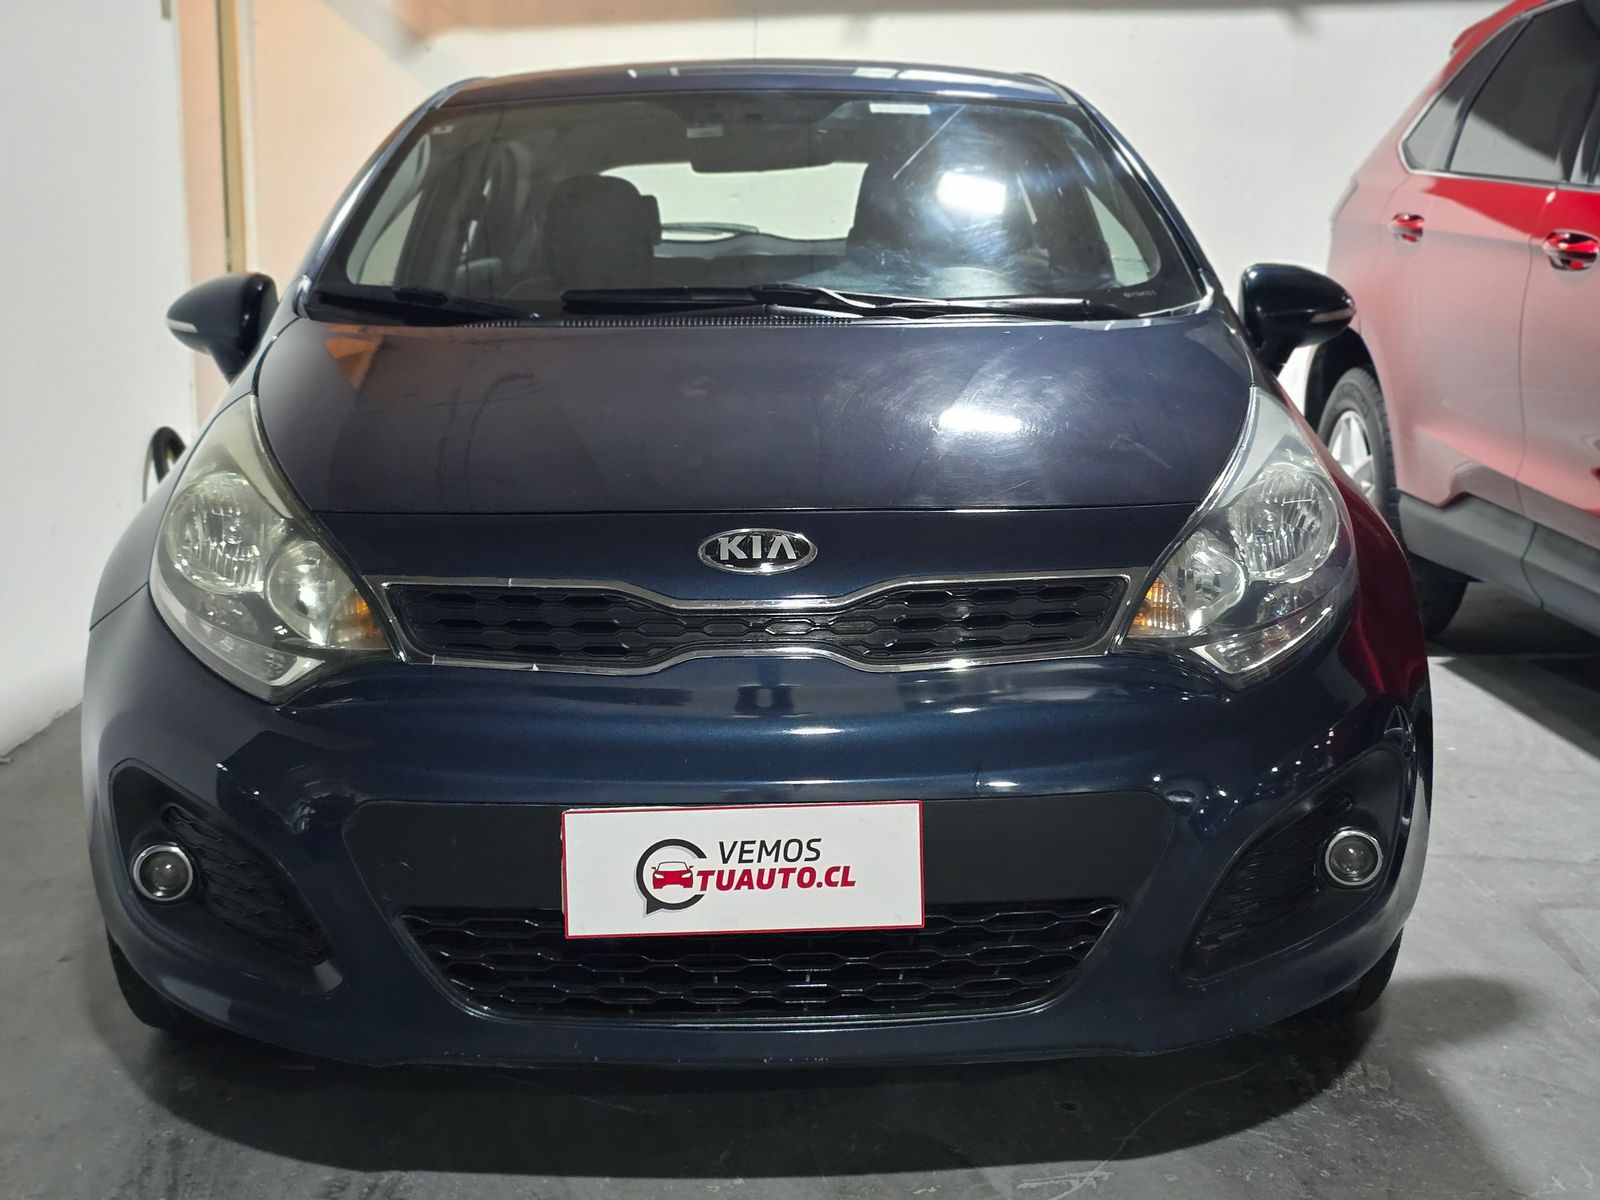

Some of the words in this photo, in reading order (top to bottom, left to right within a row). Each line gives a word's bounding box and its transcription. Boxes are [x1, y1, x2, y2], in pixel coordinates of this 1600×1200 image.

[718, 535, 797, 560] KIA
[718, 838, 822, 864] VEMOS
[696, 866, 856, 891] TUAUTO.CL
